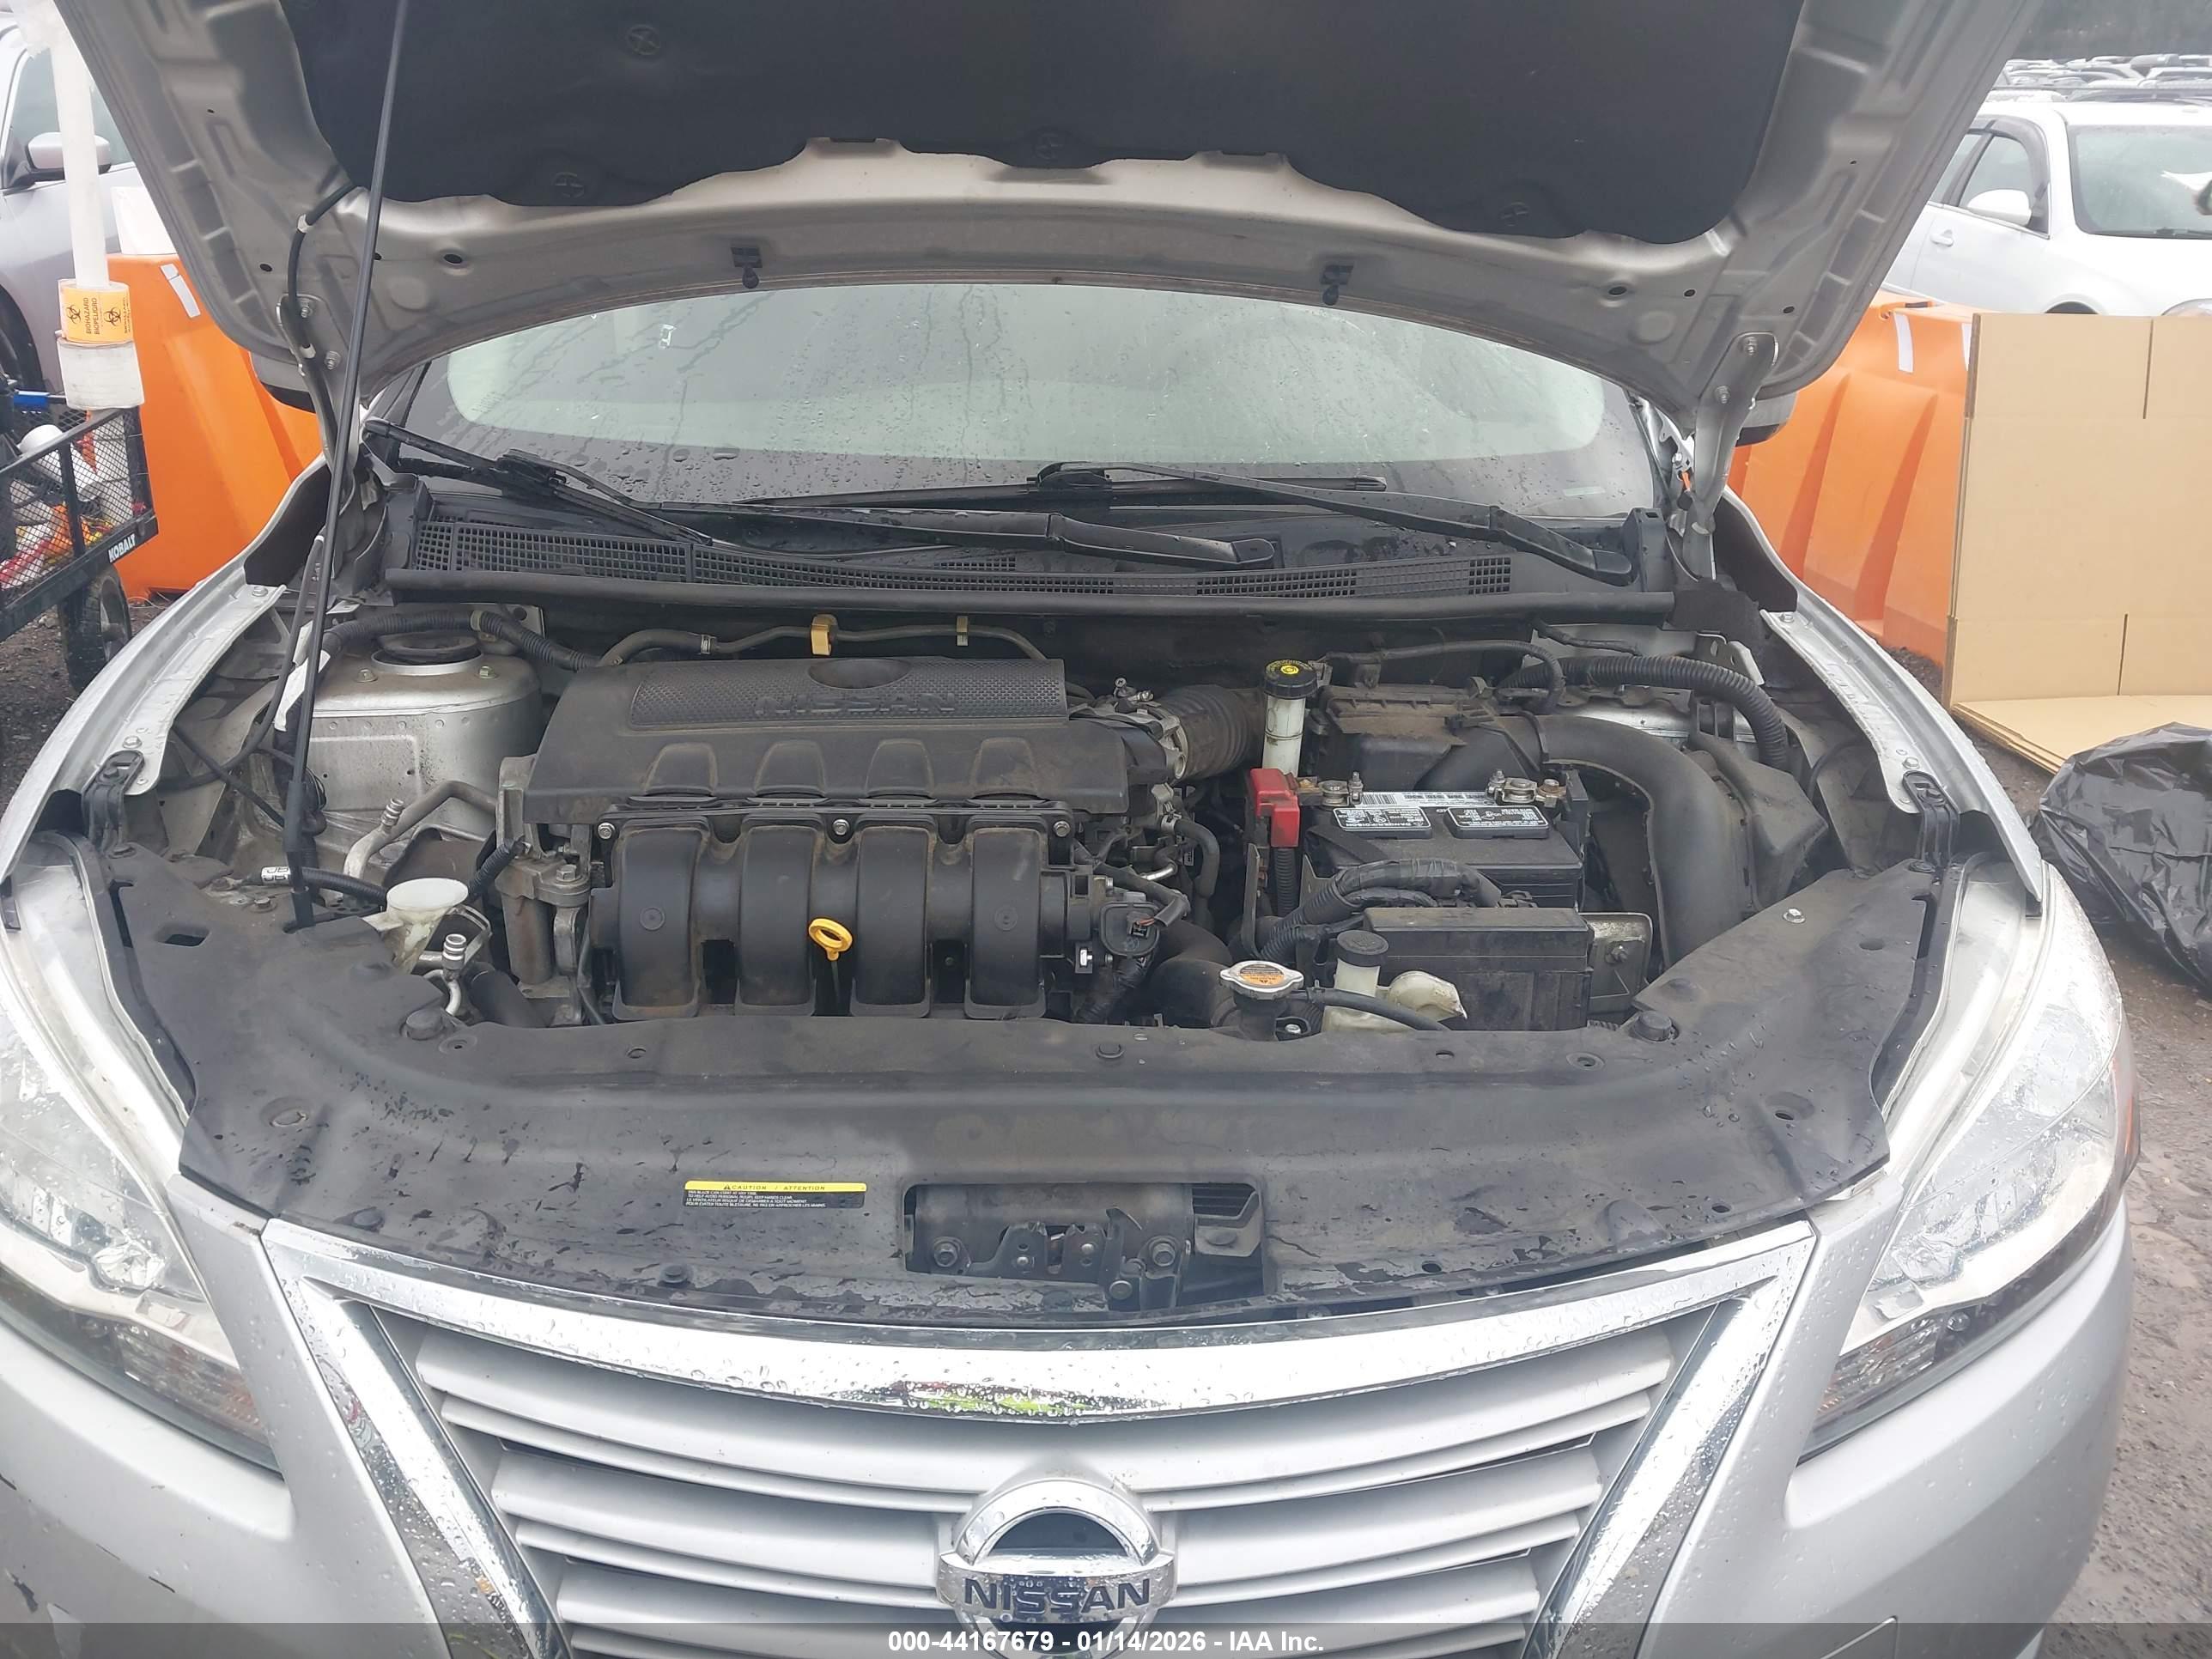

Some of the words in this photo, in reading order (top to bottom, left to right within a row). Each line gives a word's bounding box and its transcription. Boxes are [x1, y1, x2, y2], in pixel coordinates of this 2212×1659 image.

[83, 297, 92, 334] BIOHAZARD
[92, 297, 100, 335] BIOPELIGRO
[108, 532, 136, 563] KOBALT
[755, 692, 956, 714] NISSAN
[963, 1577, 1151, 1615] NISSAN
